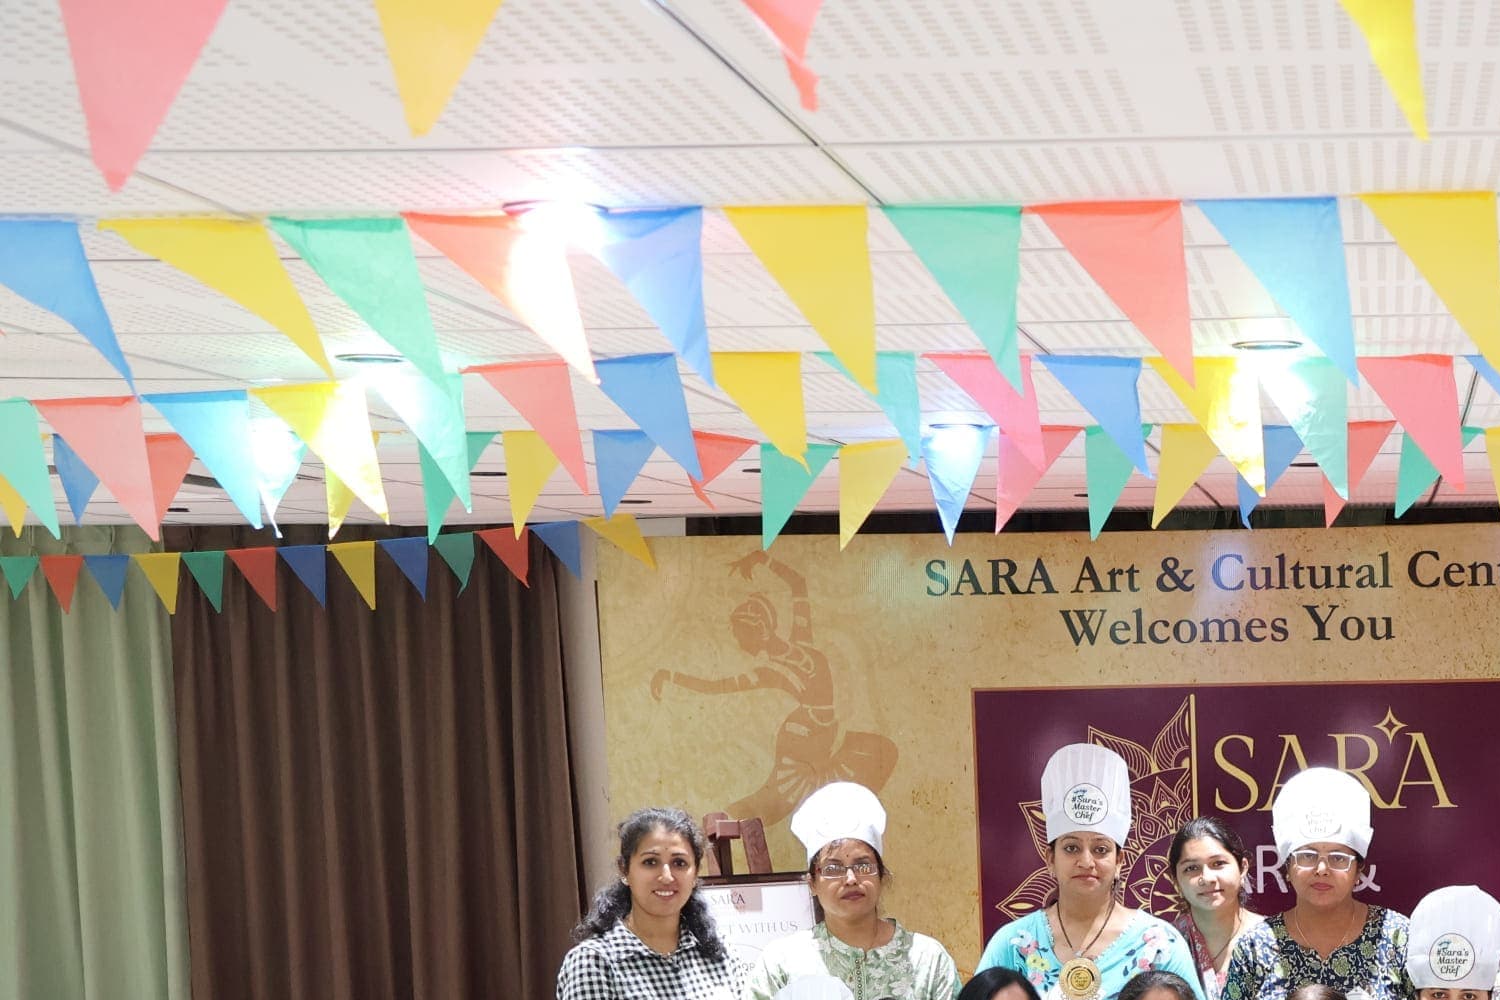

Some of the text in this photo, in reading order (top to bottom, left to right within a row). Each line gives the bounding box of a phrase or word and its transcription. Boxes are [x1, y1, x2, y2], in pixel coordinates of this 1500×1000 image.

[925, 558, 1059, 597] SARA
[1073, 556, 1140, 593] Art
[1154, 557, 1196, 592] &
[1210, 552, 1394, 592] Cultural
[1058, 603, 1397, 646] Welcomes You
[1071, 794, 1103, 806] #Sara's
[1072, 802, 1101, 812] Master
[1075, 810, 1094, 822] Chef
[1437, 948, 1469, 957] #Sara's
[1437, 955, 1468, 965] Master
[1440, 965, 1461, 978] Chef
